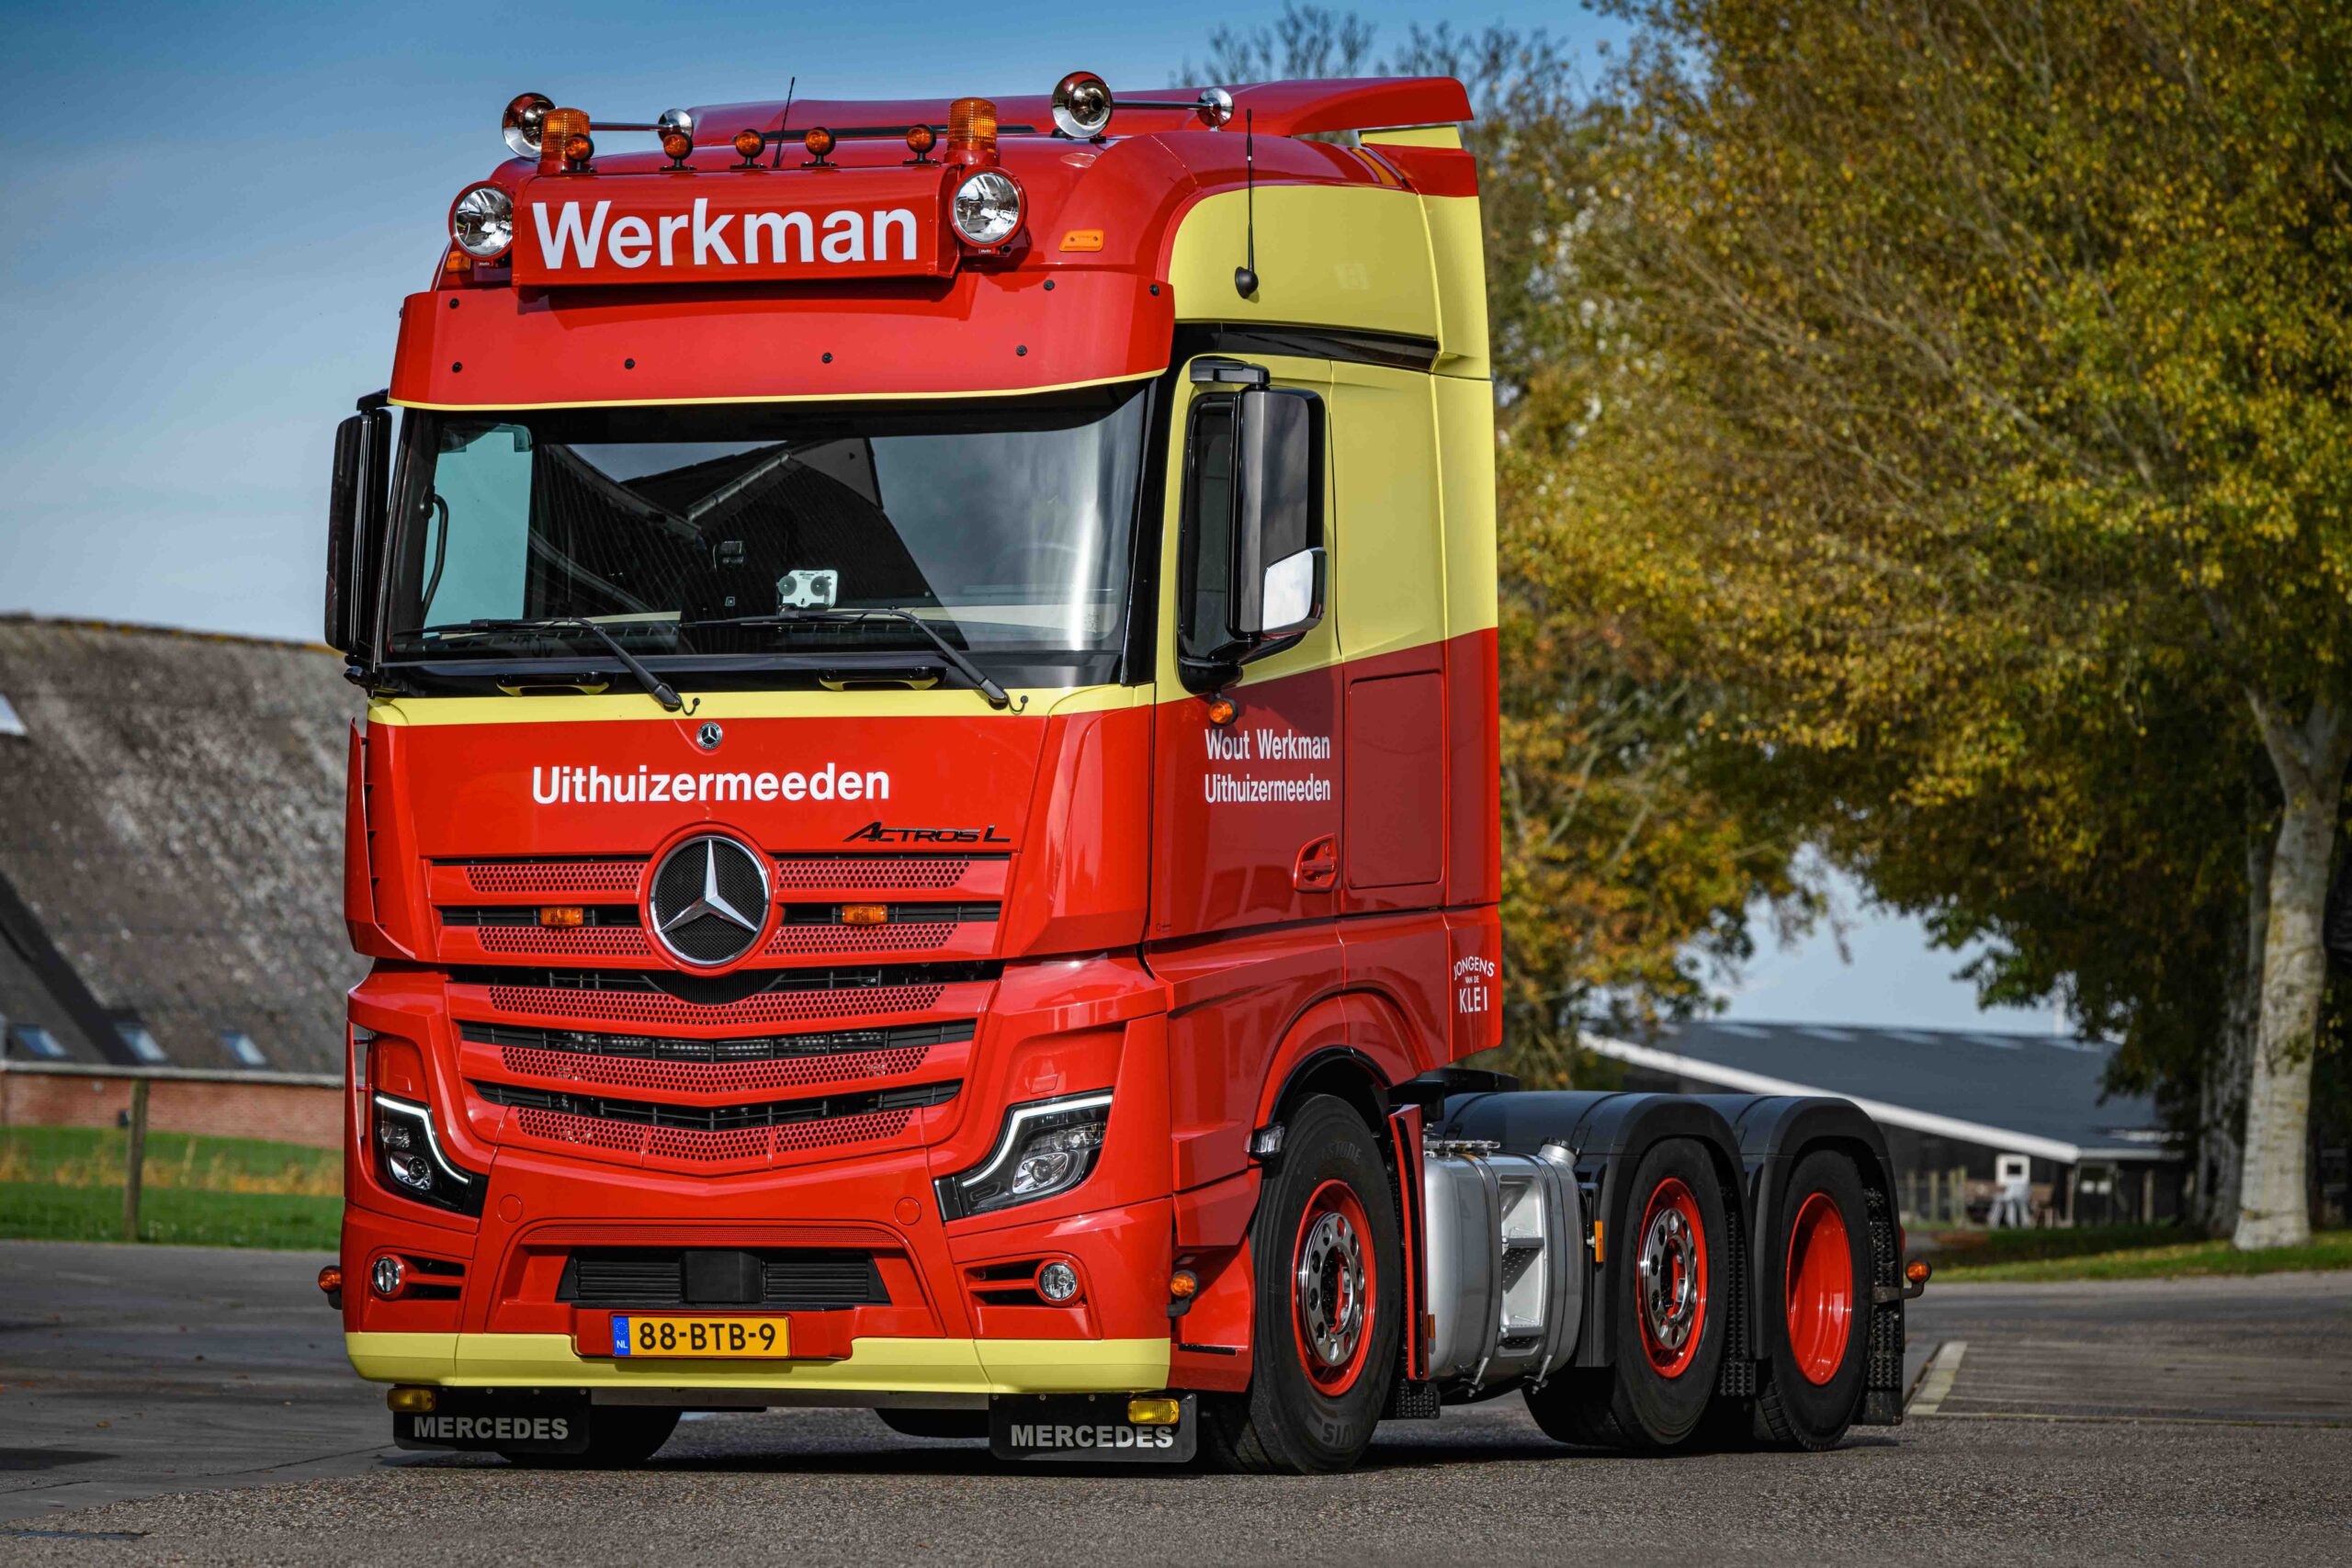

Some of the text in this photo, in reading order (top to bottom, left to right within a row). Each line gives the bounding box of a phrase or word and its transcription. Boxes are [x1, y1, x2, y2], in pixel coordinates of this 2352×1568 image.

[532, 197, 917, 269] Werkman
[1204, 728, 1330, 760] Wout Werkman
[533, 762, 889, 805] Uithuizermeeden
[1204, 773, 1330, 803] Uithuizermeeden
[842, 821, 1011, 842] ACTROS L
[1453, 956, 1495, 981] JONGENS
[1459, 986, 1487, 1013] KLEI
[616, 1340, 628, 1348] NL
[639, 1322, 775, 1350] 88-BTB-9
[414, 1416, 569, 1439] MERCEDES
[1011, 1425, 1173, 1448] MERCEDES
